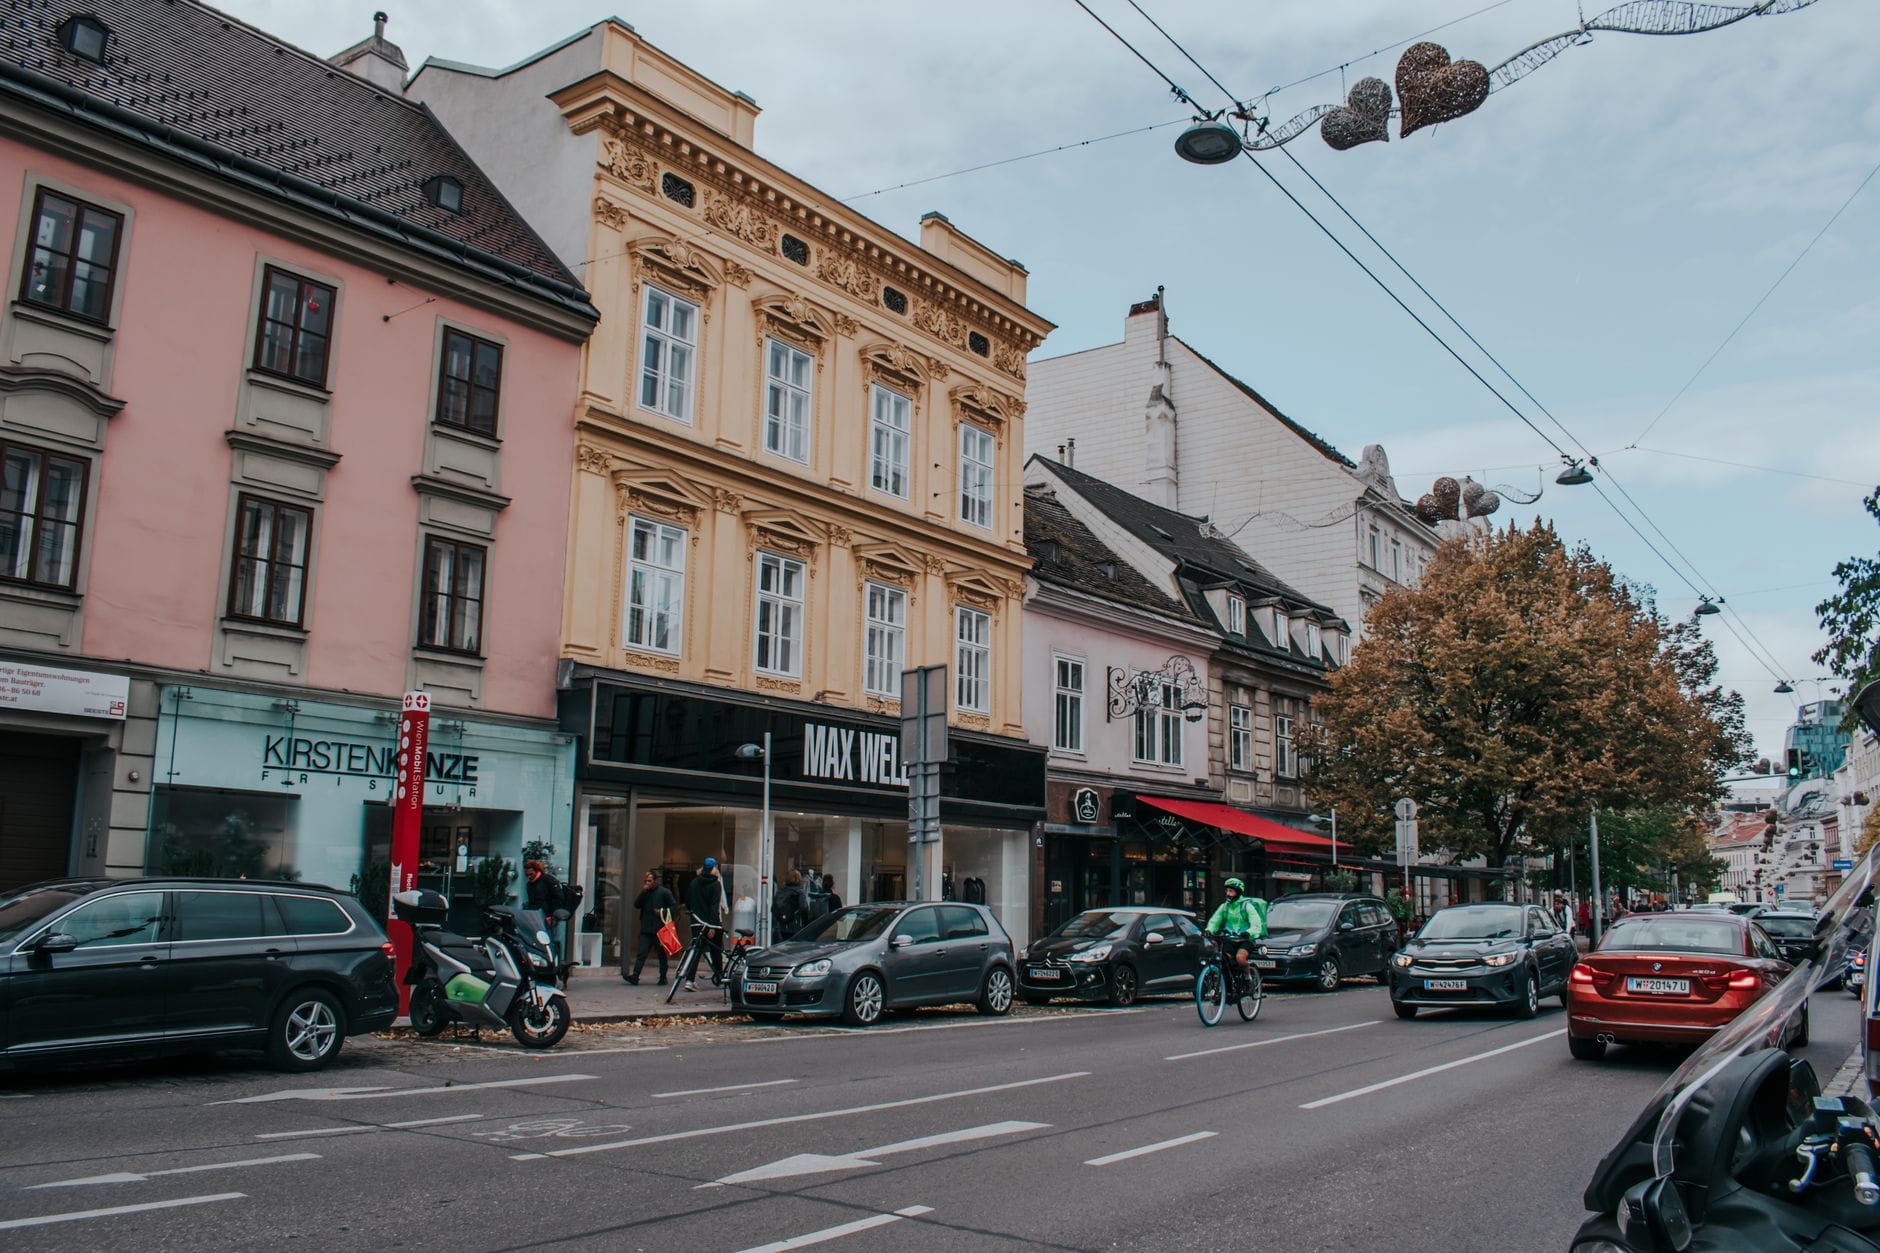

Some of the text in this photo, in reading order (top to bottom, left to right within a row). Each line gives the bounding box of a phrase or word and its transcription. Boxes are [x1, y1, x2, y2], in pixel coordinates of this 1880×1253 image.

[17, 668, 90, 683] Eigentumswohnungen
[264, 734, 479, 782] KIRSTENKNZE
[803, 722, 854, 781] MAX
[261, 770, 477, 797] FRISUR
[1635, 980, 1687, 991] W 20147 U
